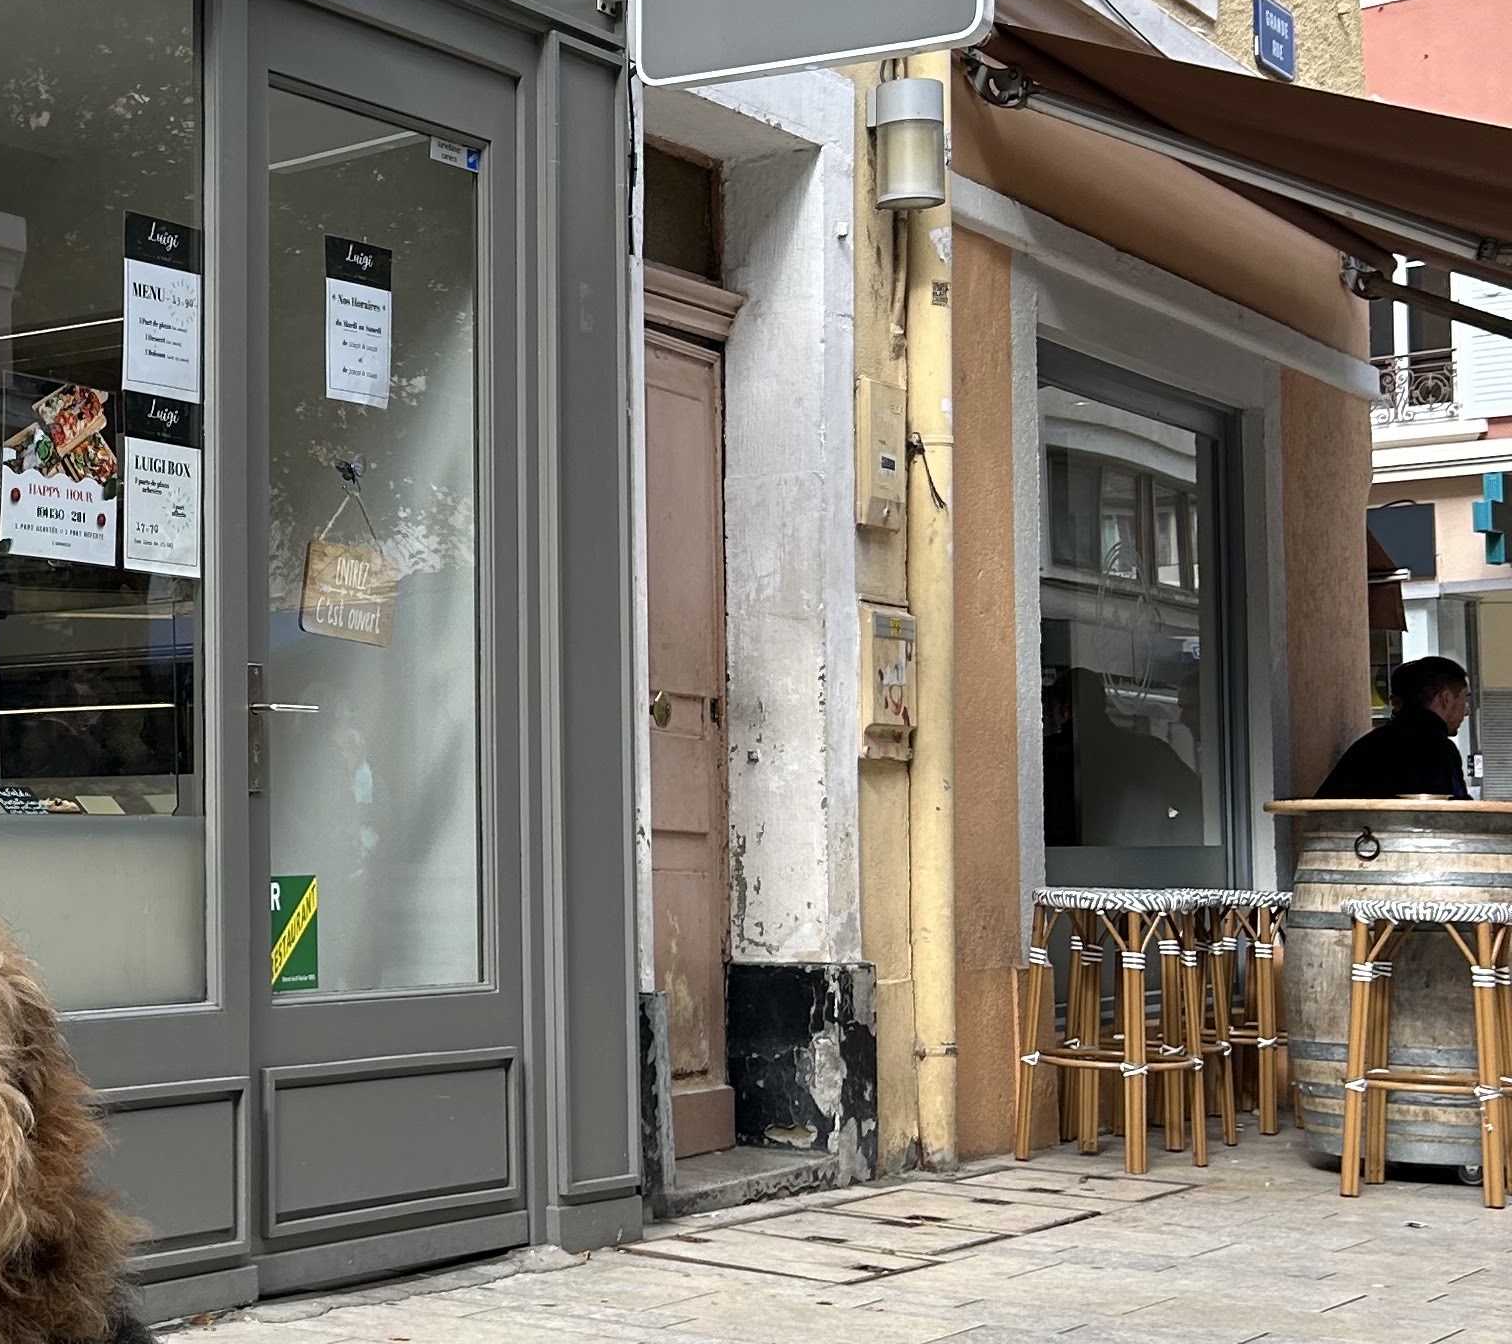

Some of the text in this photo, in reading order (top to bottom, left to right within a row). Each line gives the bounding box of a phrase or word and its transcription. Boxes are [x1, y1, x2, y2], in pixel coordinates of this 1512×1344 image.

[147, 221, 179, 252] Luigi
[345, 244, 374, 271] Luigi
[132, 281, 165, 302] MENU
[147, 399, 180, 427] Luigi
[134, 454, 192, 478] LUIGI BOX
[28, 483, 94, 504] HAPPY HOUR
[316, 596, 381, 634] C'est ouvert
[271, 883, 317, 974] ESTAURANT
